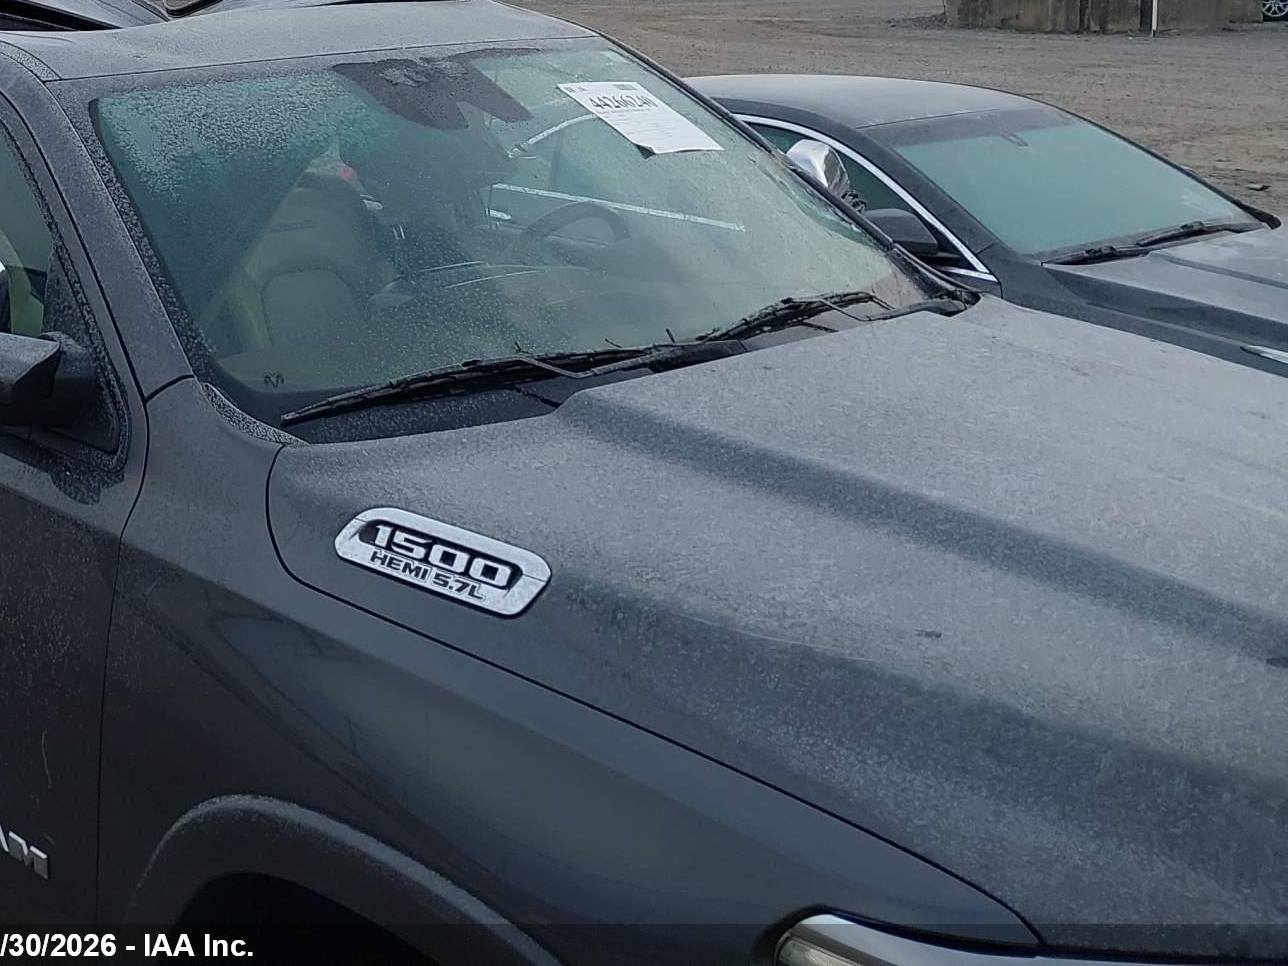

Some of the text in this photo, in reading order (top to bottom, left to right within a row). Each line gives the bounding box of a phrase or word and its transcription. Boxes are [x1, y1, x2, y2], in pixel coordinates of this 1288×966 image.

[369, 550, 486, 600] HEMI 5.7L
[374, 524, 513, 587] 1500
